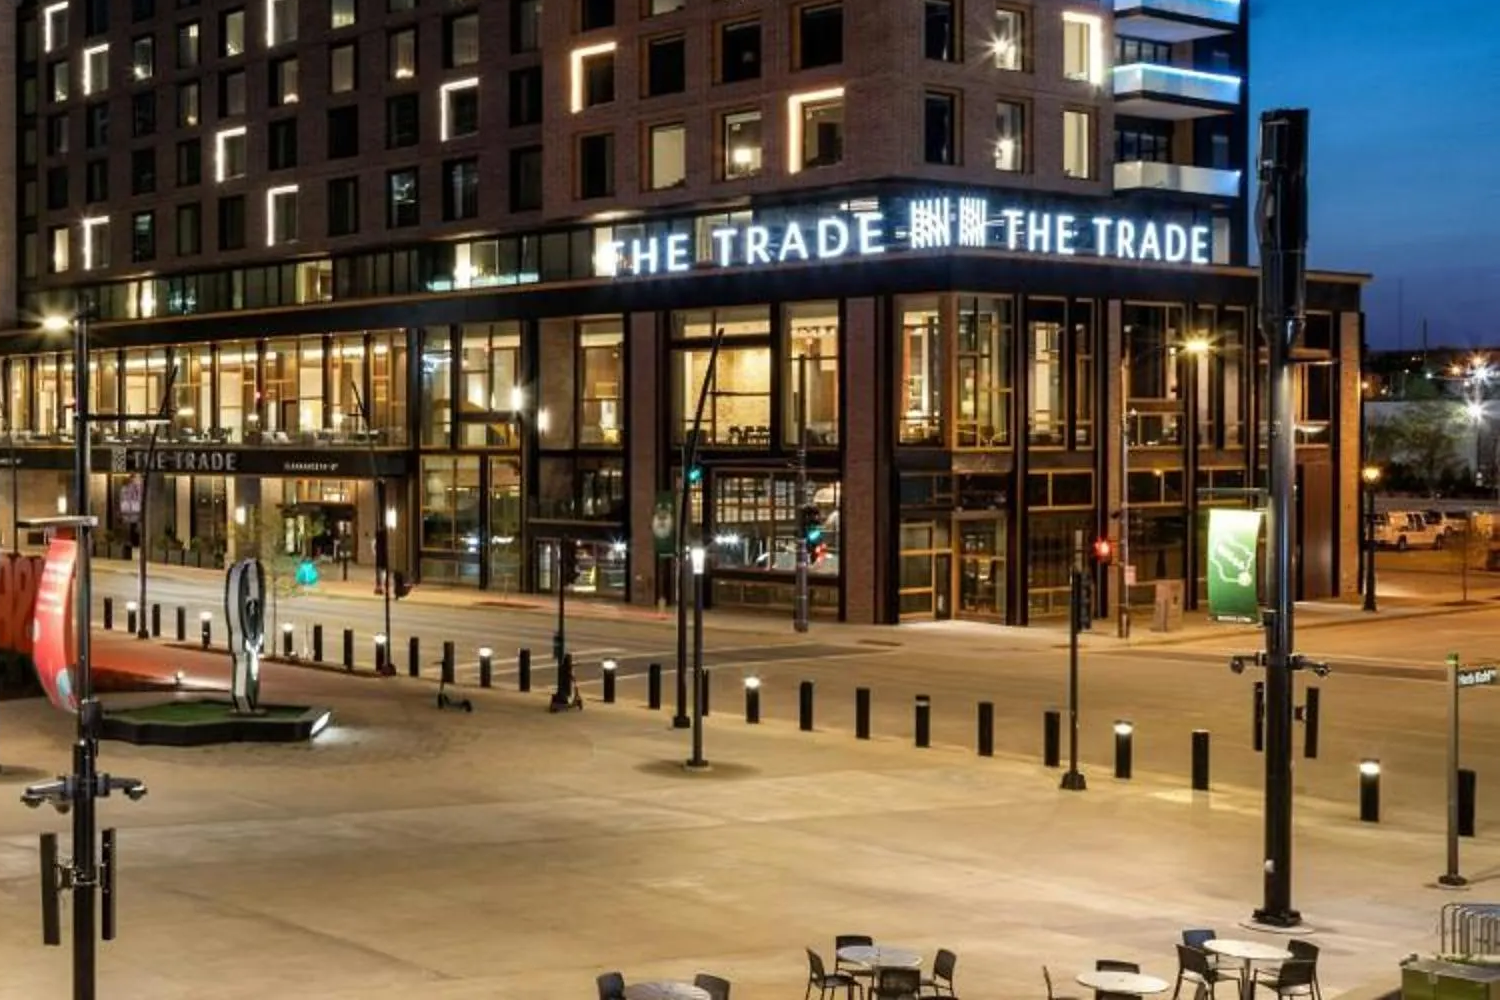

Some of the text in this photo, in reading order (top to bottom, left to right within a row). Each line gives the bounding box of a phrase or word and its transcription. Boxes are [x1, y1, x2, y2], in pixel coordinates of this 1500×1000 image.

[605, 212, 886, 276] THE TRADE
[1004, 209, 1210, 263] THE TRADE
[174, 452, 238, 471] TRADE
